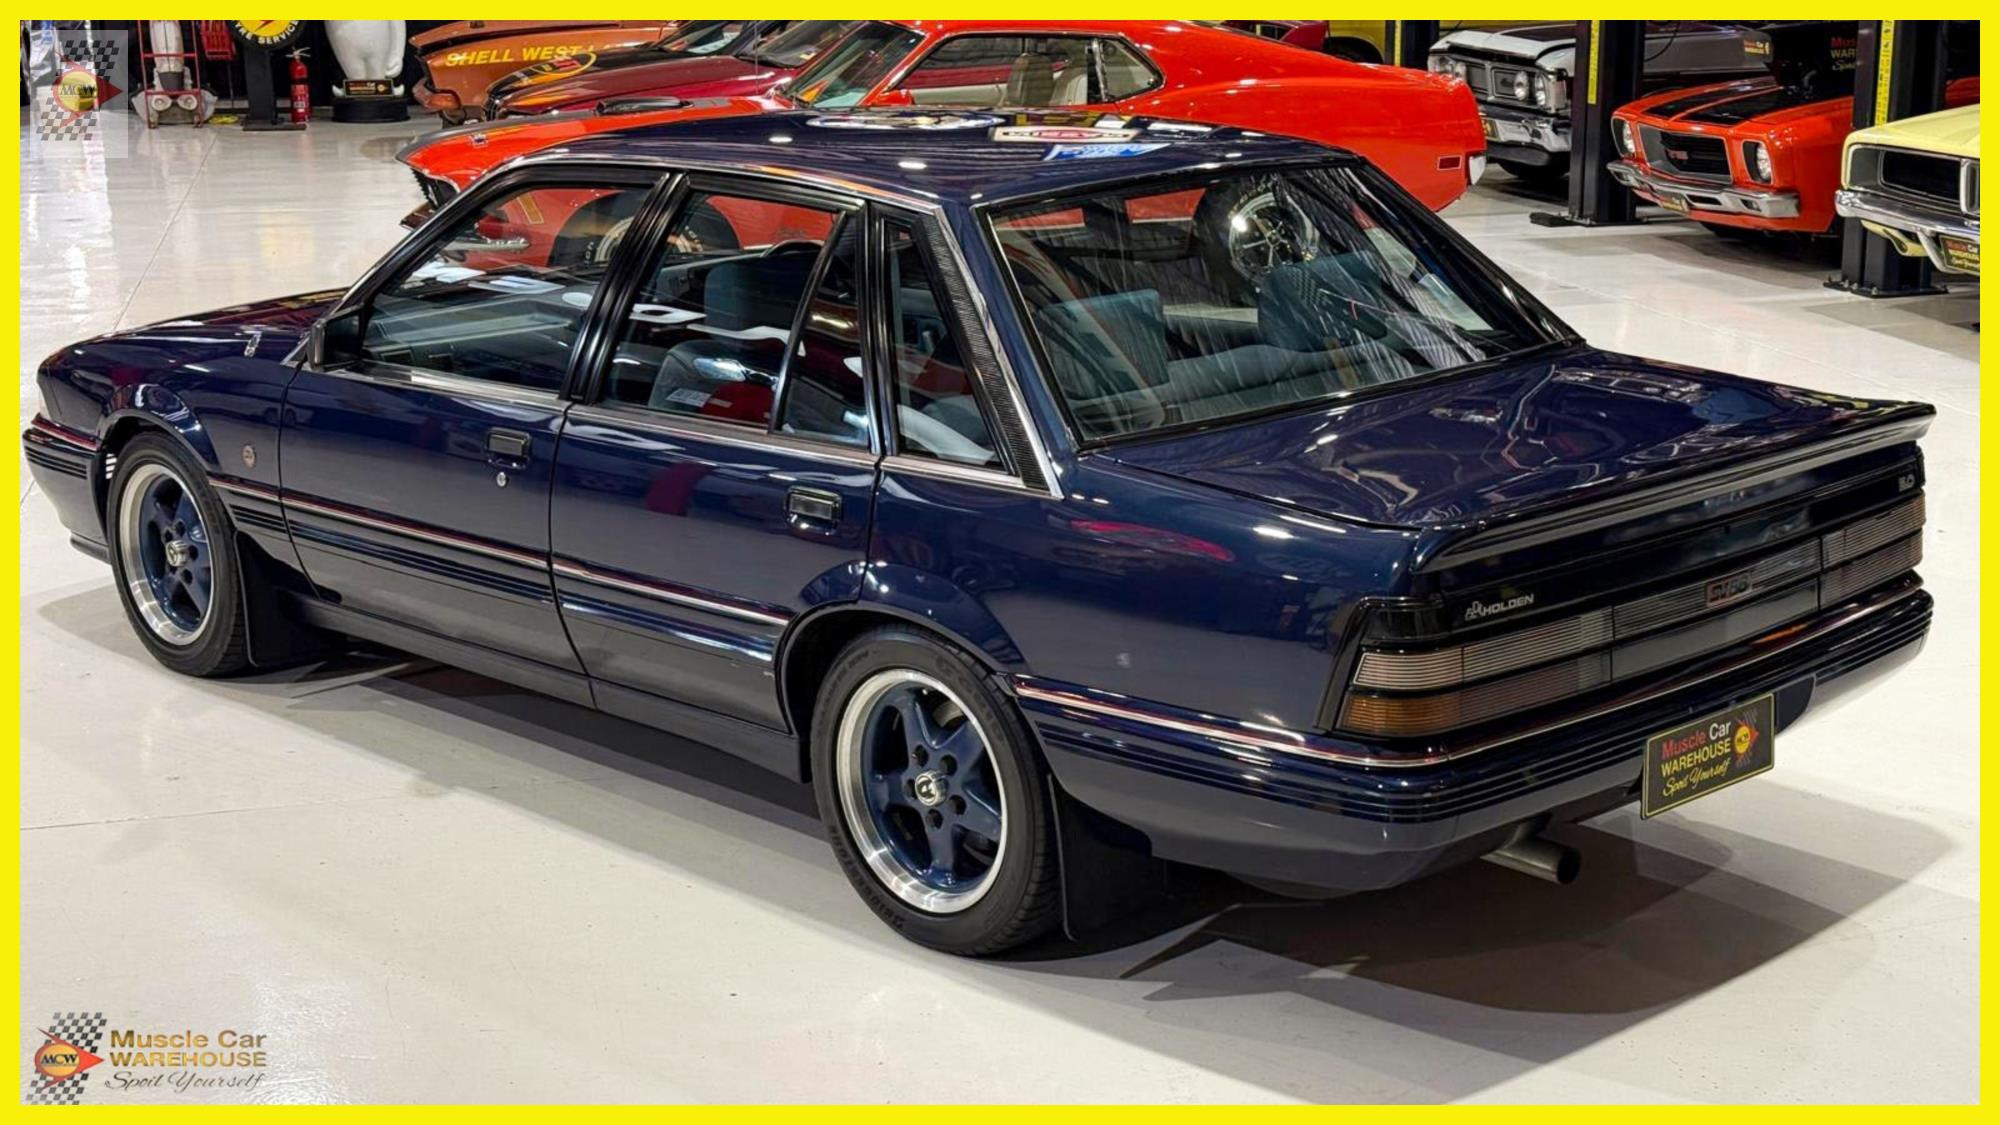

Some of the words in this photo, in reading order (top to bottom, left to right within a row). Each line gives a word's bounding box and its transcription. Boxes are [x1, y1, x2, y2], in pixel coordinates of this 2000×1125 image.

[233, 20, 253, 40] YRE
[445, 49, 514, 67] SHELL
[521, 44, 582, 61] WEST
[1482, 594, 1534, 617] HOLDEN
[1663, 730, 1706, 759] Muscle
[1709, 721, 1731, 740] Car
[1661, 738, 1731, 777] WAREHOUSE
